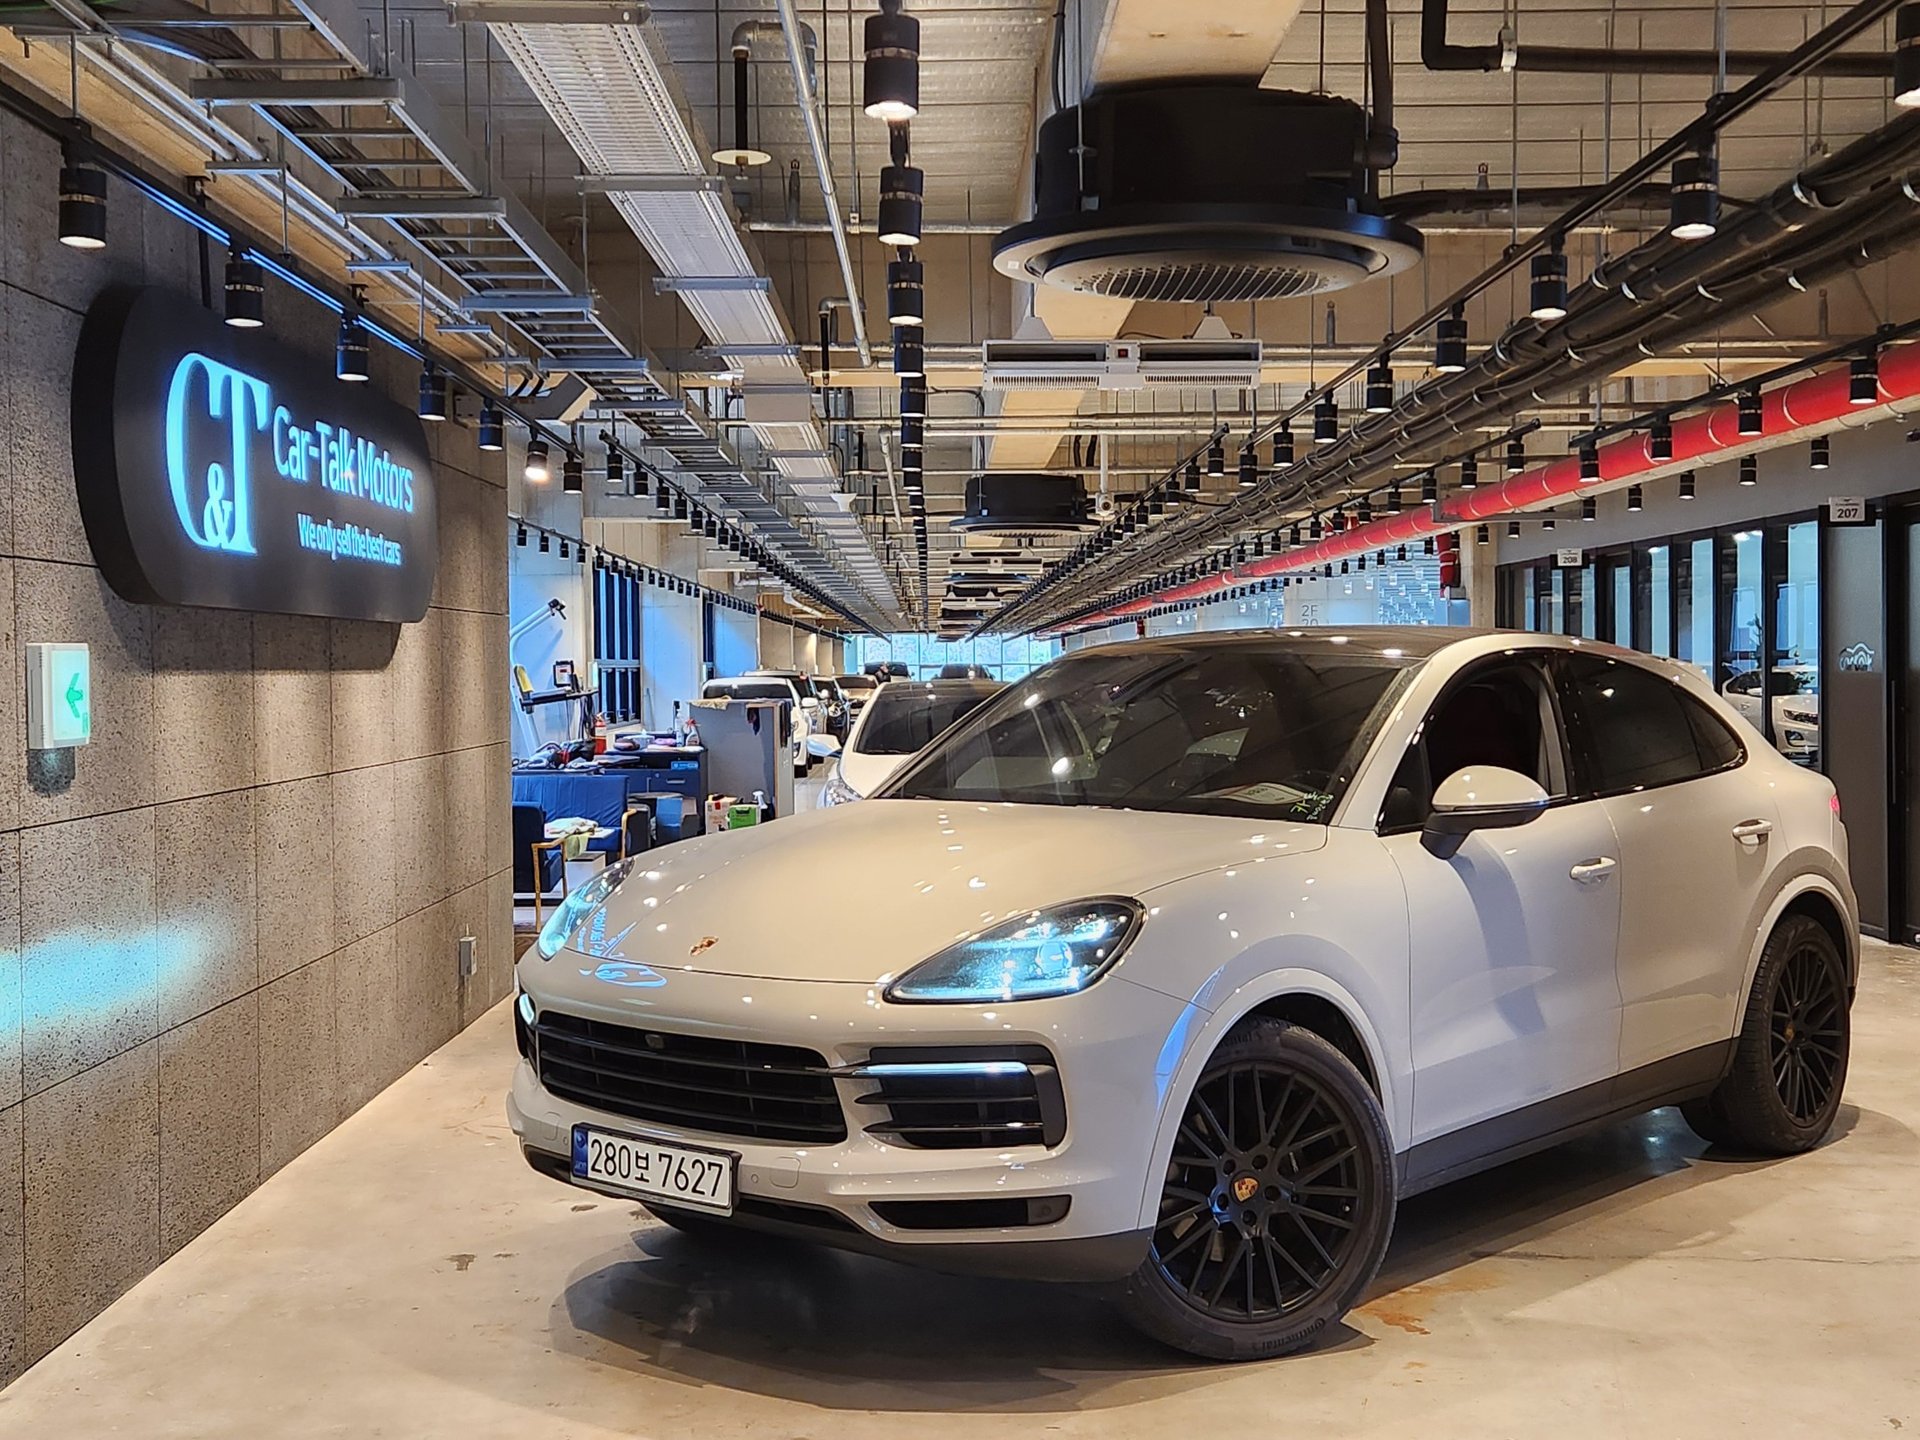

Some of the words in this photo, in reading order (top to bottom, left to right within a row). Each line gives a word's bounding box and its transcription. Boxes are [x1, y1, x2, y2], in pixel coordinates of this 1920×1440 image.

[272, 404, 357, 496] Car-Talk
[356, 435, 414, 514] Motors
[297, 512, 317, 550] We
[316, 518, 337, 561] only
[336, 522, 352, 556] sell
[350, 524, 367, 559] the
[365, 527, 385, 562] best
[383, 539, 402, 567] cars
[1837, 508, 1859, 519] 207
[1301, 604, 1319, 617] 2F
[590, 1138, 650, 1184] 280보
[658, 1152, 724, 1198] 7627
